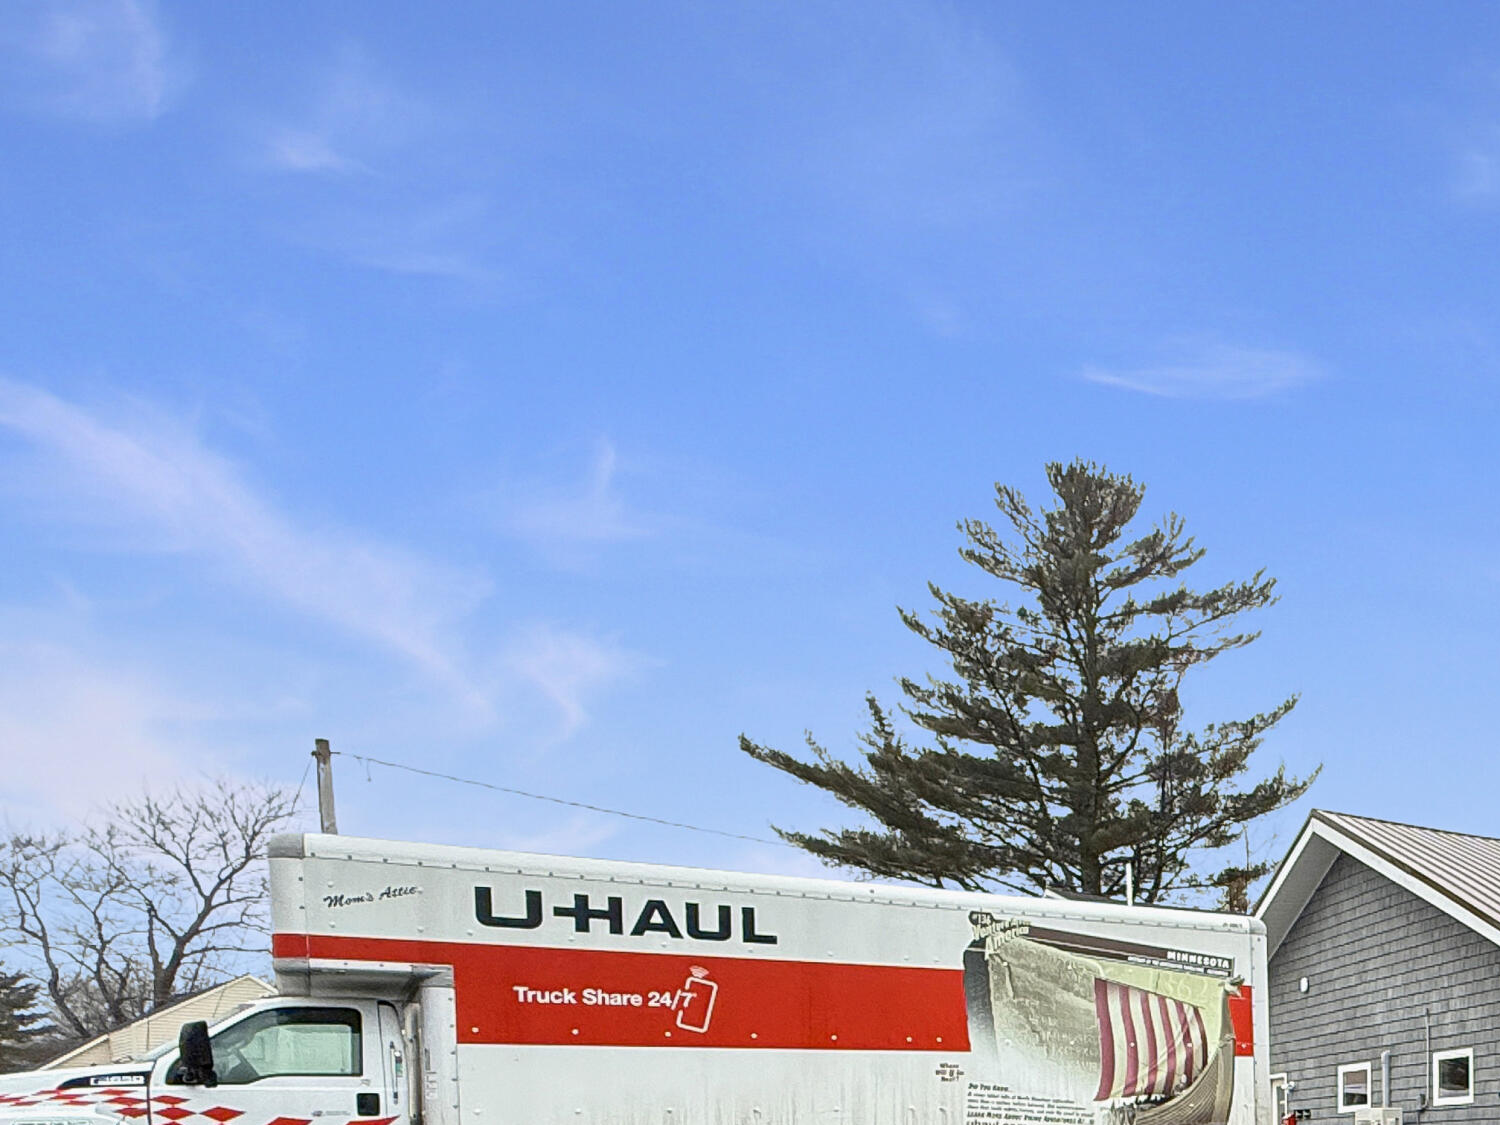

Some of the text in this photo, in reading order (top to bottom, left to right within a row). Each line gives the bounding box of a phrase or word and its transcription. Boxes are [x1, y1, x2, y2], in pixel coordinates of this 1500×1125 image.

[474, 886, 778, 945] U-HAUL
[1166, 950, 1230, 969] MINNESOTA
[512, 985, 697, 1011] Truck Share 24/7
